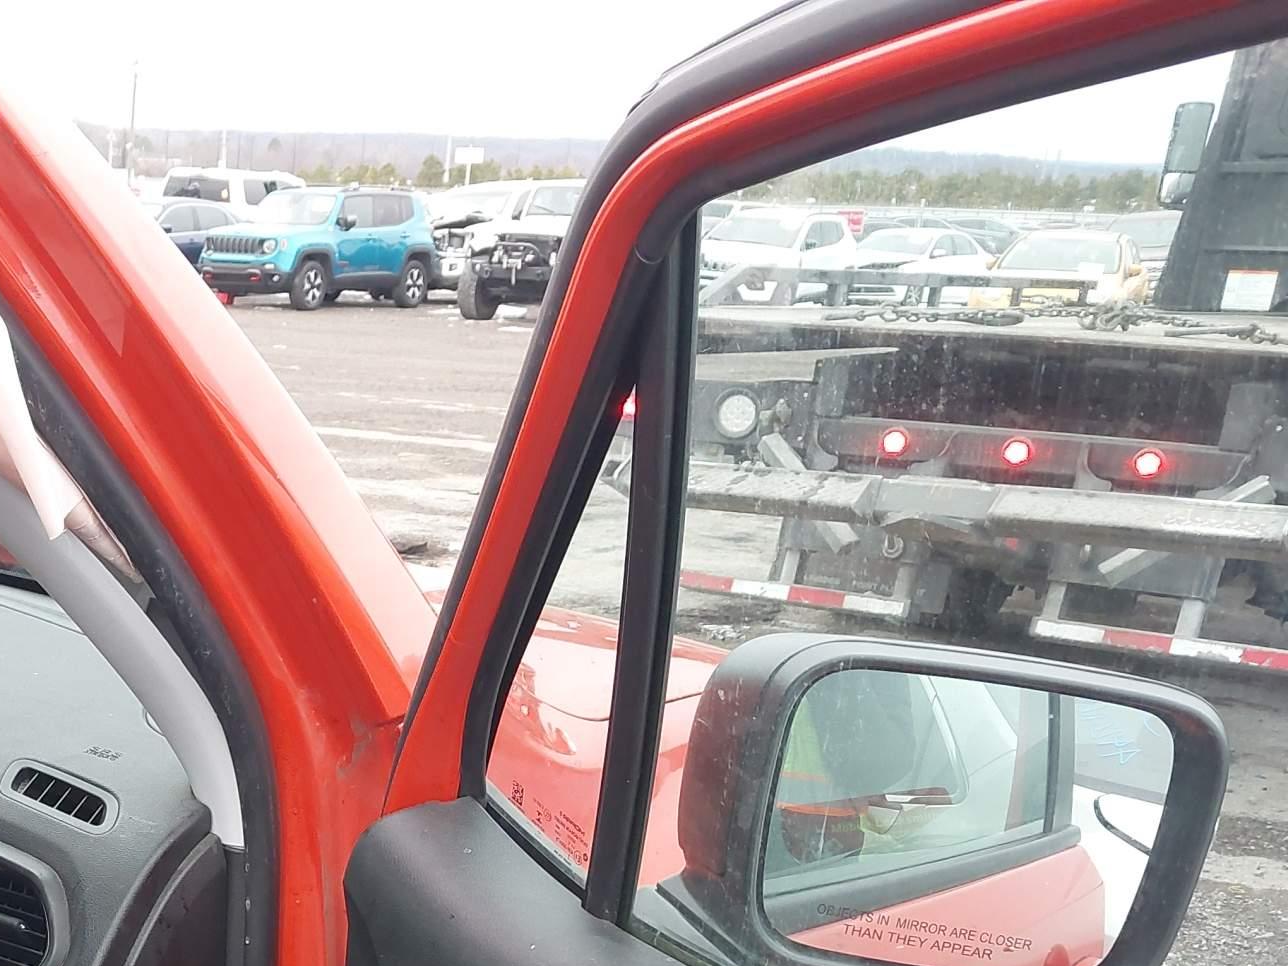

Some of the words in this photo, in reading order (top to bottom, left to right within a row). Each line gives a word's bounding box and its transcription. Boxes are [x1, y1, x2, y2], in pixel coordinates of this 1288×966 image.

[816, 903, 874, 924] OBJECTS
[877, 913, 890, 925] IN
[896, 917, 948, 937] MIRROR
[950, 924, 977, 941] ARE
[979, 929, 1032, 951] CLOSER
[843, 924, 884, 942] THAN
[888, 931, 929, 948] THEY
[930, 939, 993, 960] APPEAR
